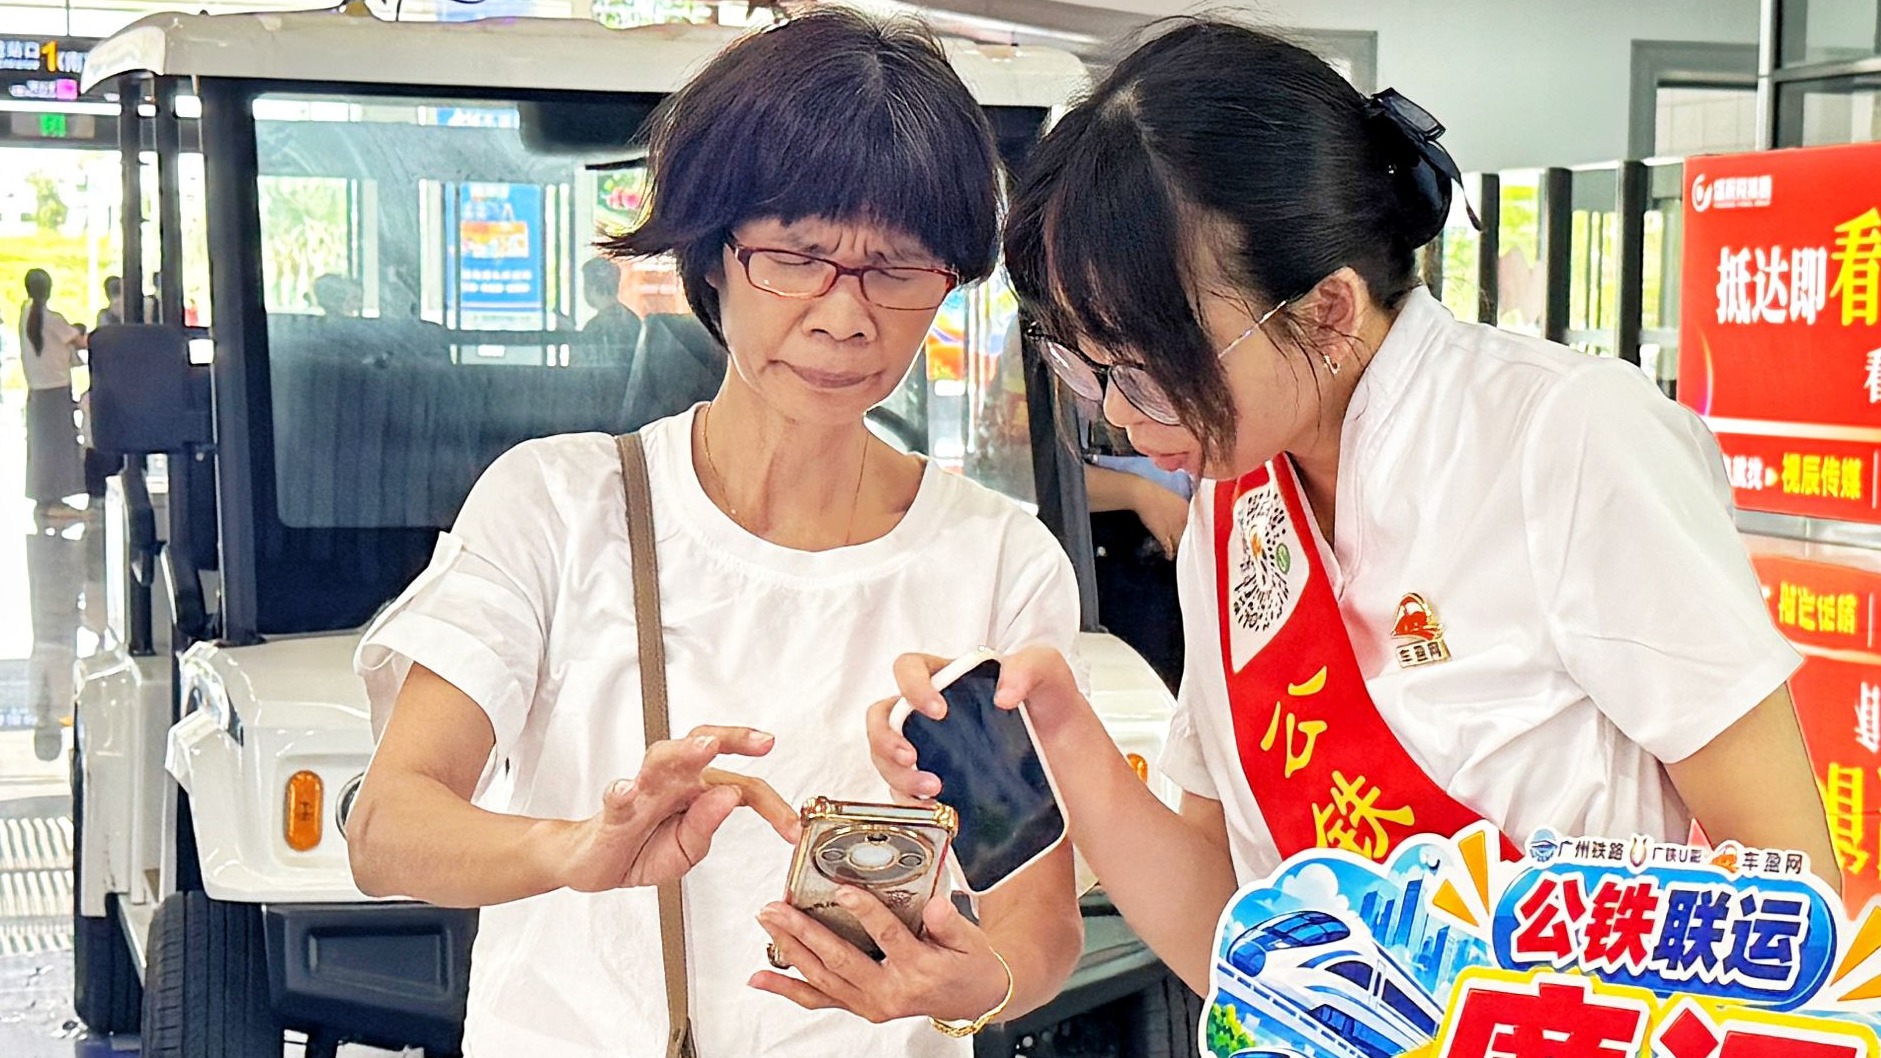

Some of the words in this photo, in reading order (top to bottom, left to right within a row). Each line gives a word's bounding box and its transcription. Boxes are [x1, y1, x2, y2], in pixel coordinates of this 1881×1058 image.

[1716, 207, 1881, 326] 抵达即看
[1260, 665, 1415, 860] 公铁
[1557, 840, 1624, 861] 广州铁路
[1742, 851, 1803, 875] 车盈网
[1515, 879, 1802, 981] 公铁联运
